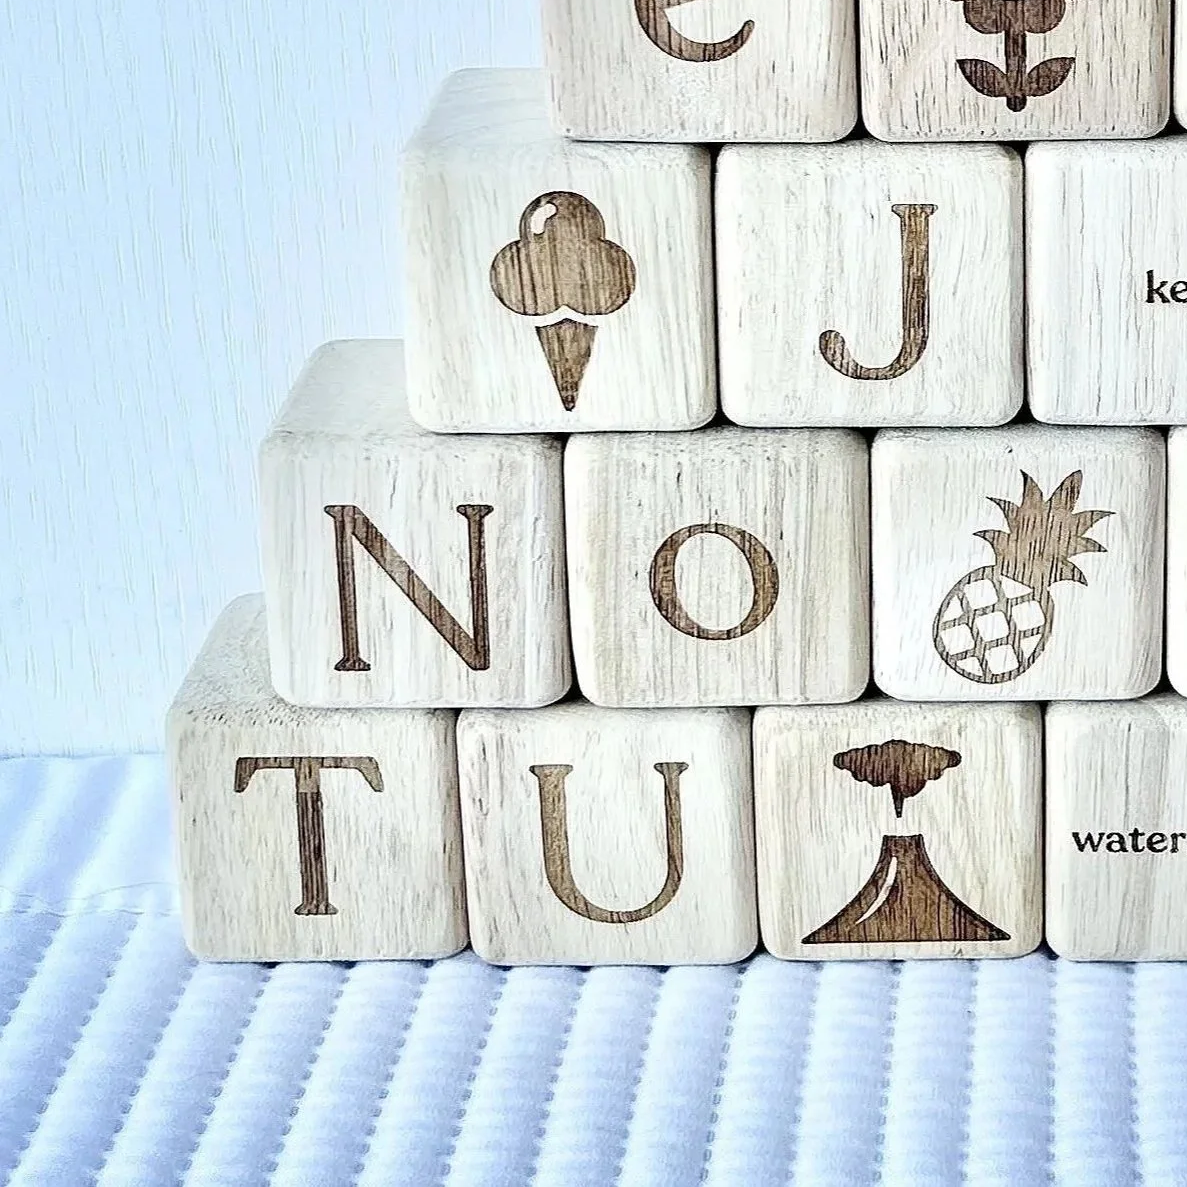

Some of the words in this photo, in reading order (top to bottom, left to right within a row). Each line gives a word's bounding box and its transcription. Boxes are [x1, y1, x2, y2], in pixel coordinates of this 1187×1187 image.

[819, 203, 938, 381] J
[324, 504, 494, 672] N
[234, 756, 383, 916] T
[529, 762, 688, 923] U
